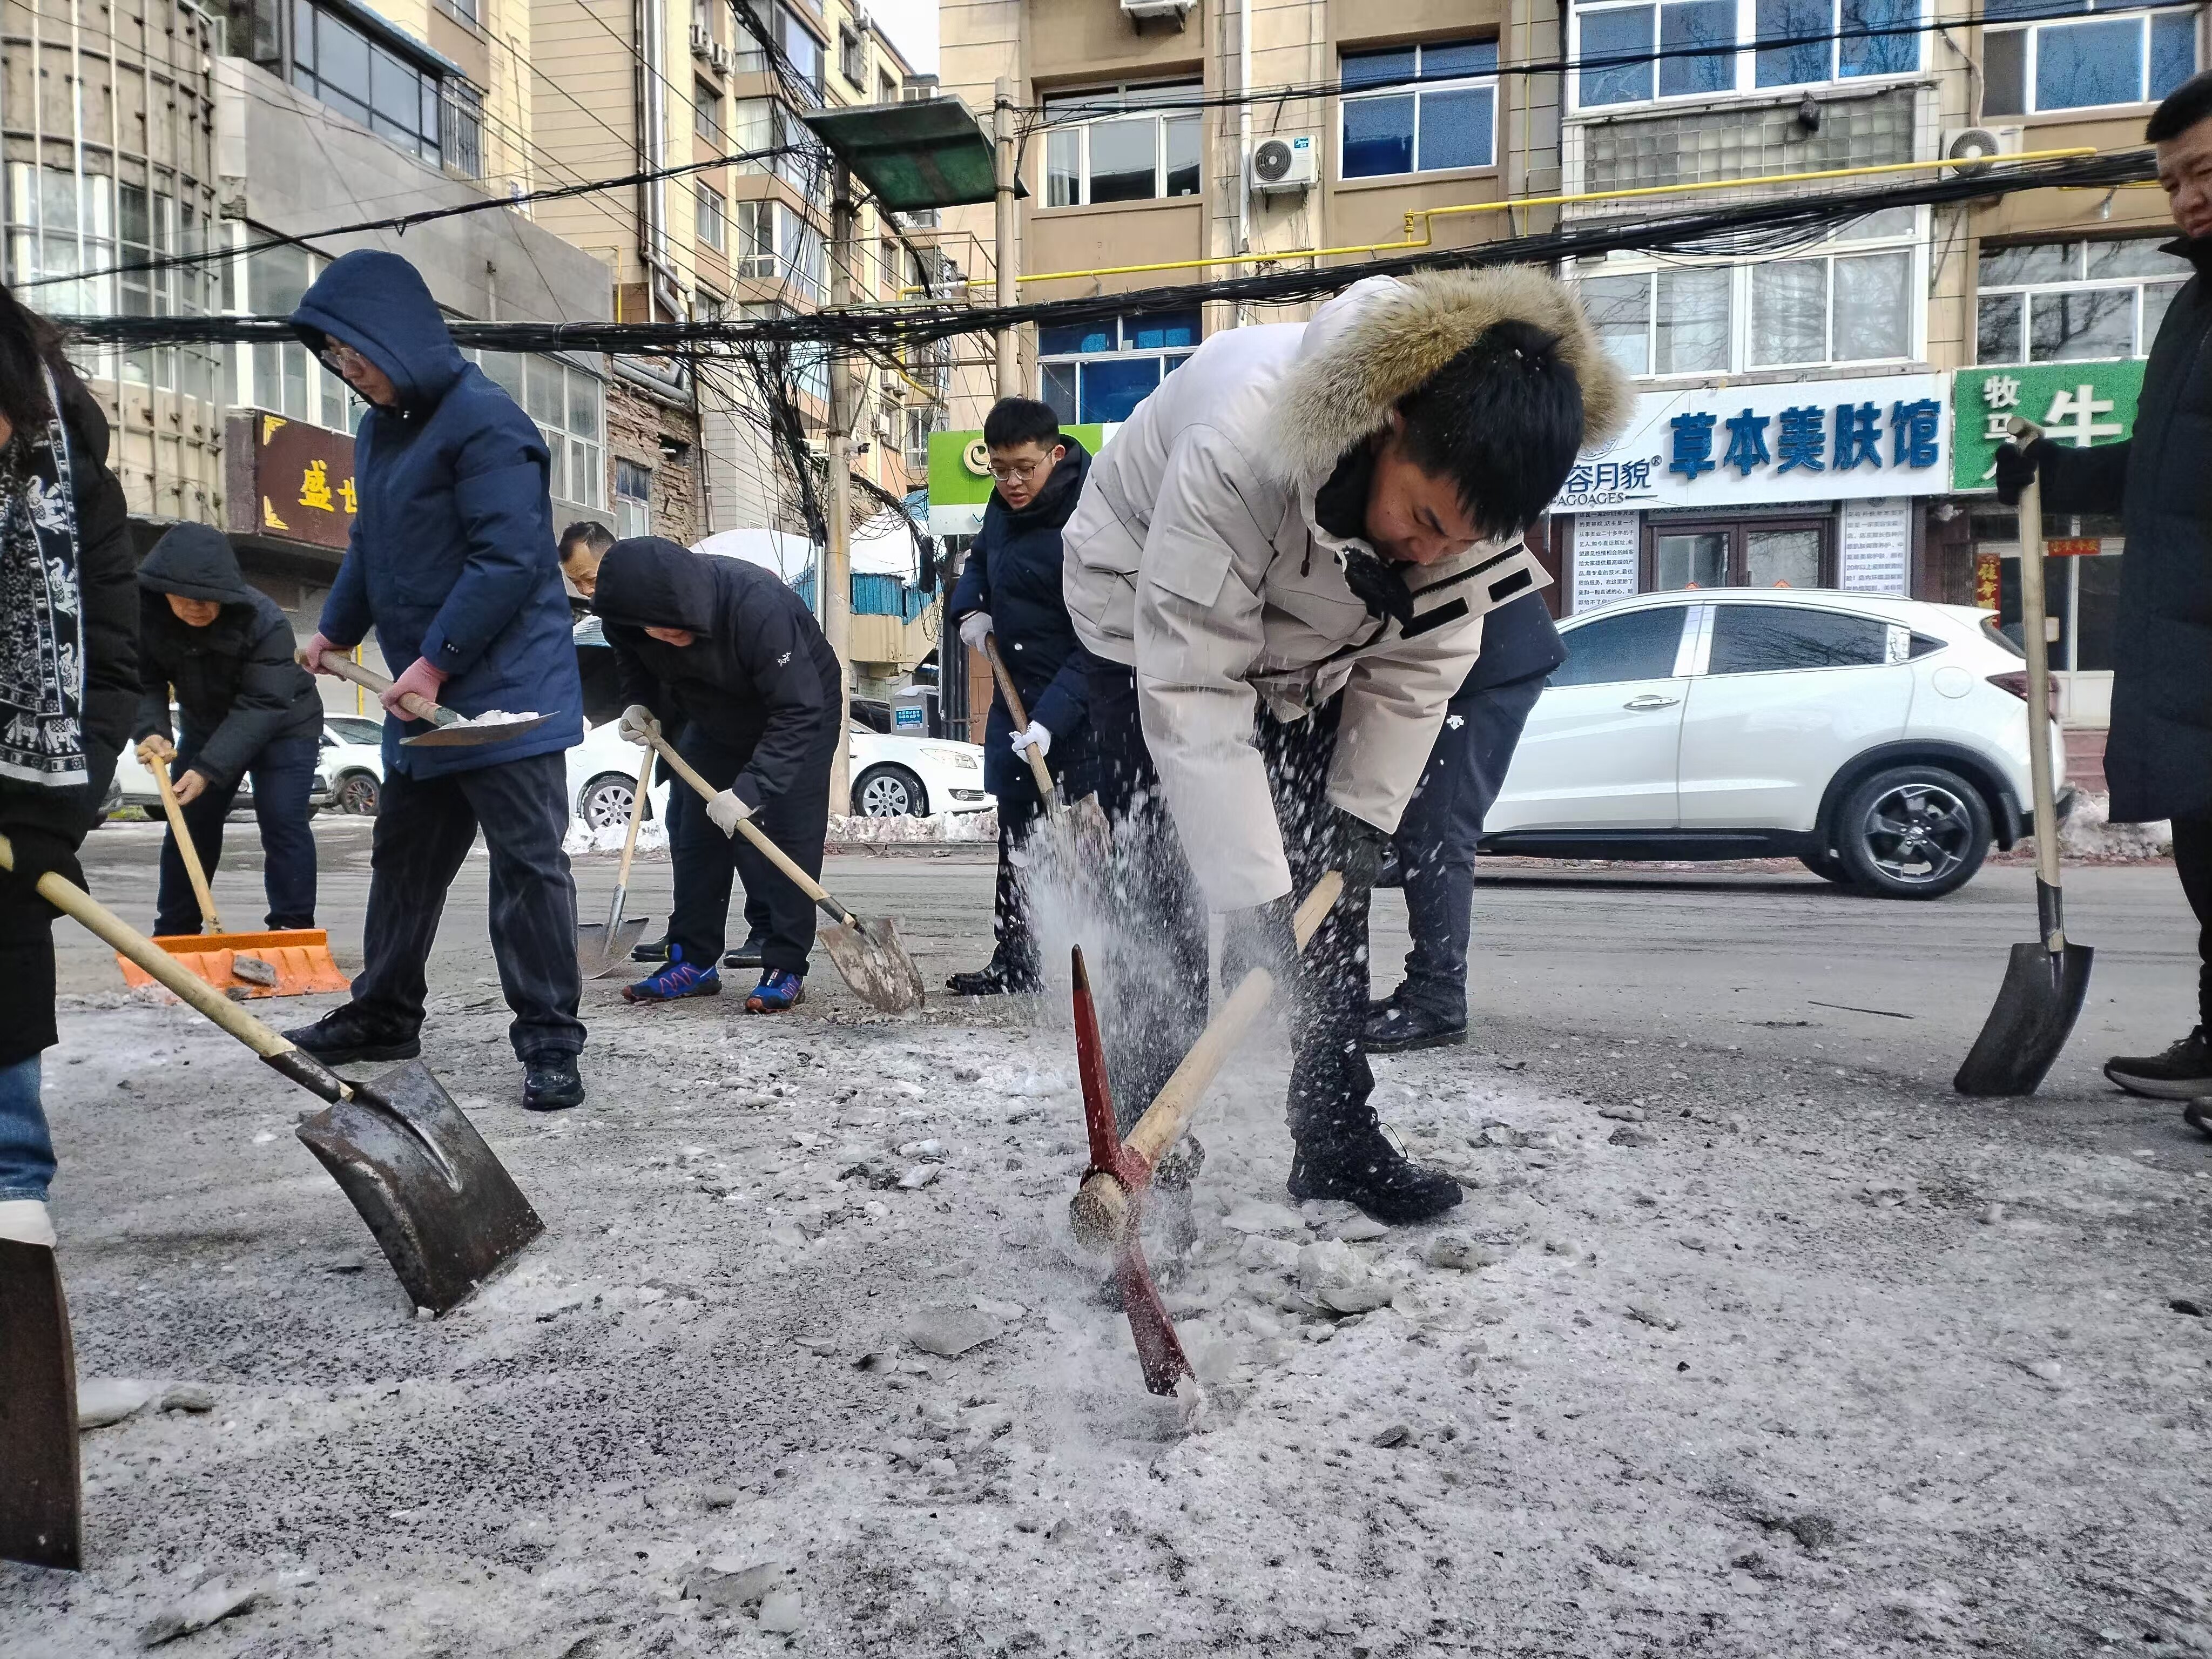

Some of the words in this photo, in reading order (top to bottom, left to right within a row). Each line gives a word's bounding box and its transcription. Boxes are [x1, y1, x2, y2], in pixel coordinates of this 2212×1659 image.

[1669, 397, 1942, 480] 草本美肤馆
[1981, 375, 2021, 480] 牧马
